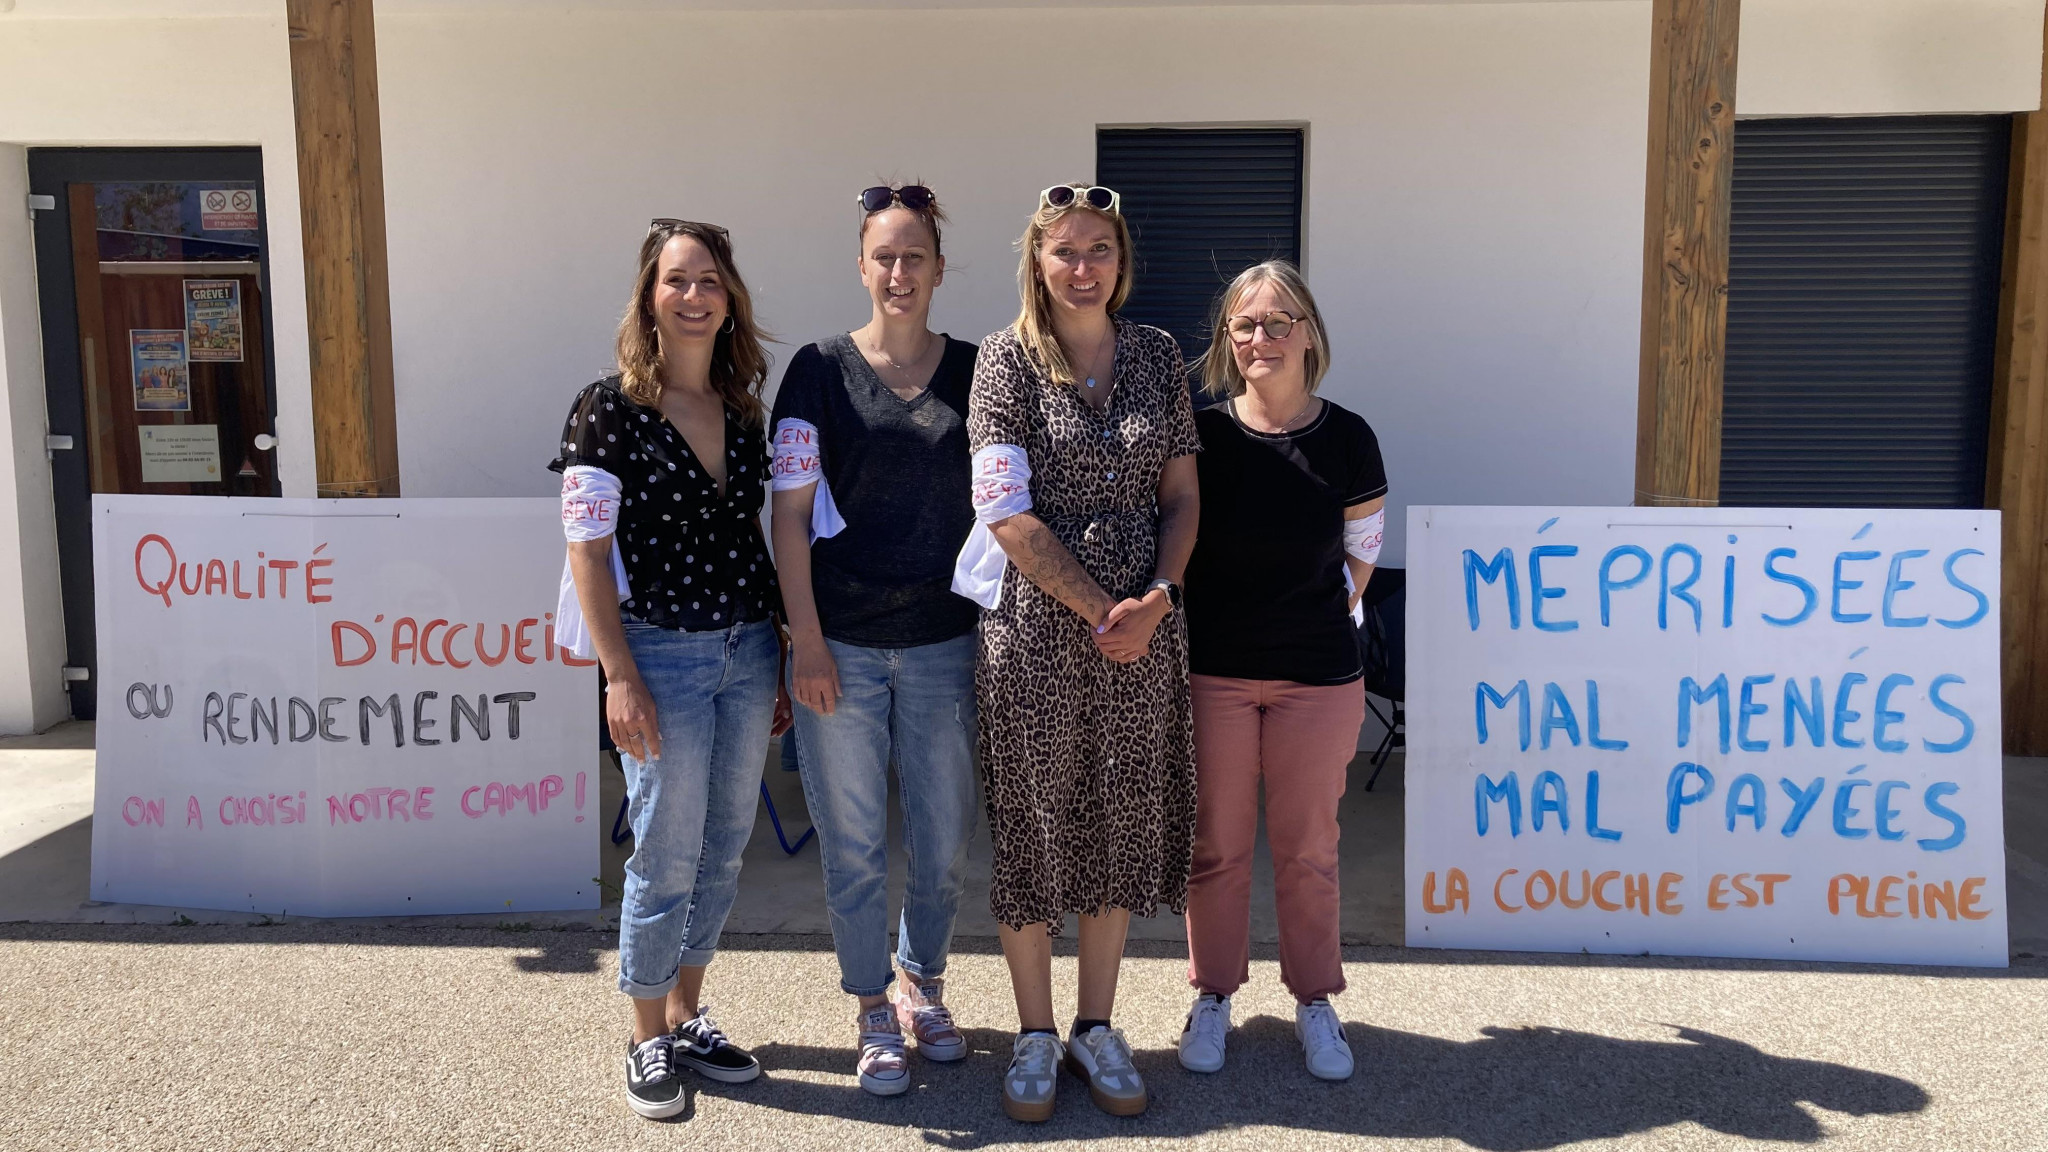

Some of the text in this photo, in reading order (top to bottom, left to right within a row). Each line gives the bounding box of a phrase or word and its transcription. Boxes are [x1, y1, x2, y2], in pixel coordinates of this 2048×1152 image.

[782, 428, 810, 444] EN
[774, 451, 821, 475] RÈVE
[983, 457, 1008, 474] EN
[562, 496, 611, 522] RÈVE
[126, 682, 537, 748] OU RENDEMENT
[1475, 647, 1976, 755] MAL MENÉES
[122, 796, 166, 827] ON
[186, 795, 203, 830] A
[325, 786, 436, 825] NOTRE
[1474, 762, 1967, 853] MAL PAYÉES
[1422, 868, 1470, 915] LA
[1493, 868, 1684, 916] COUCHE
[1707, 873, 1792, 911] EST
